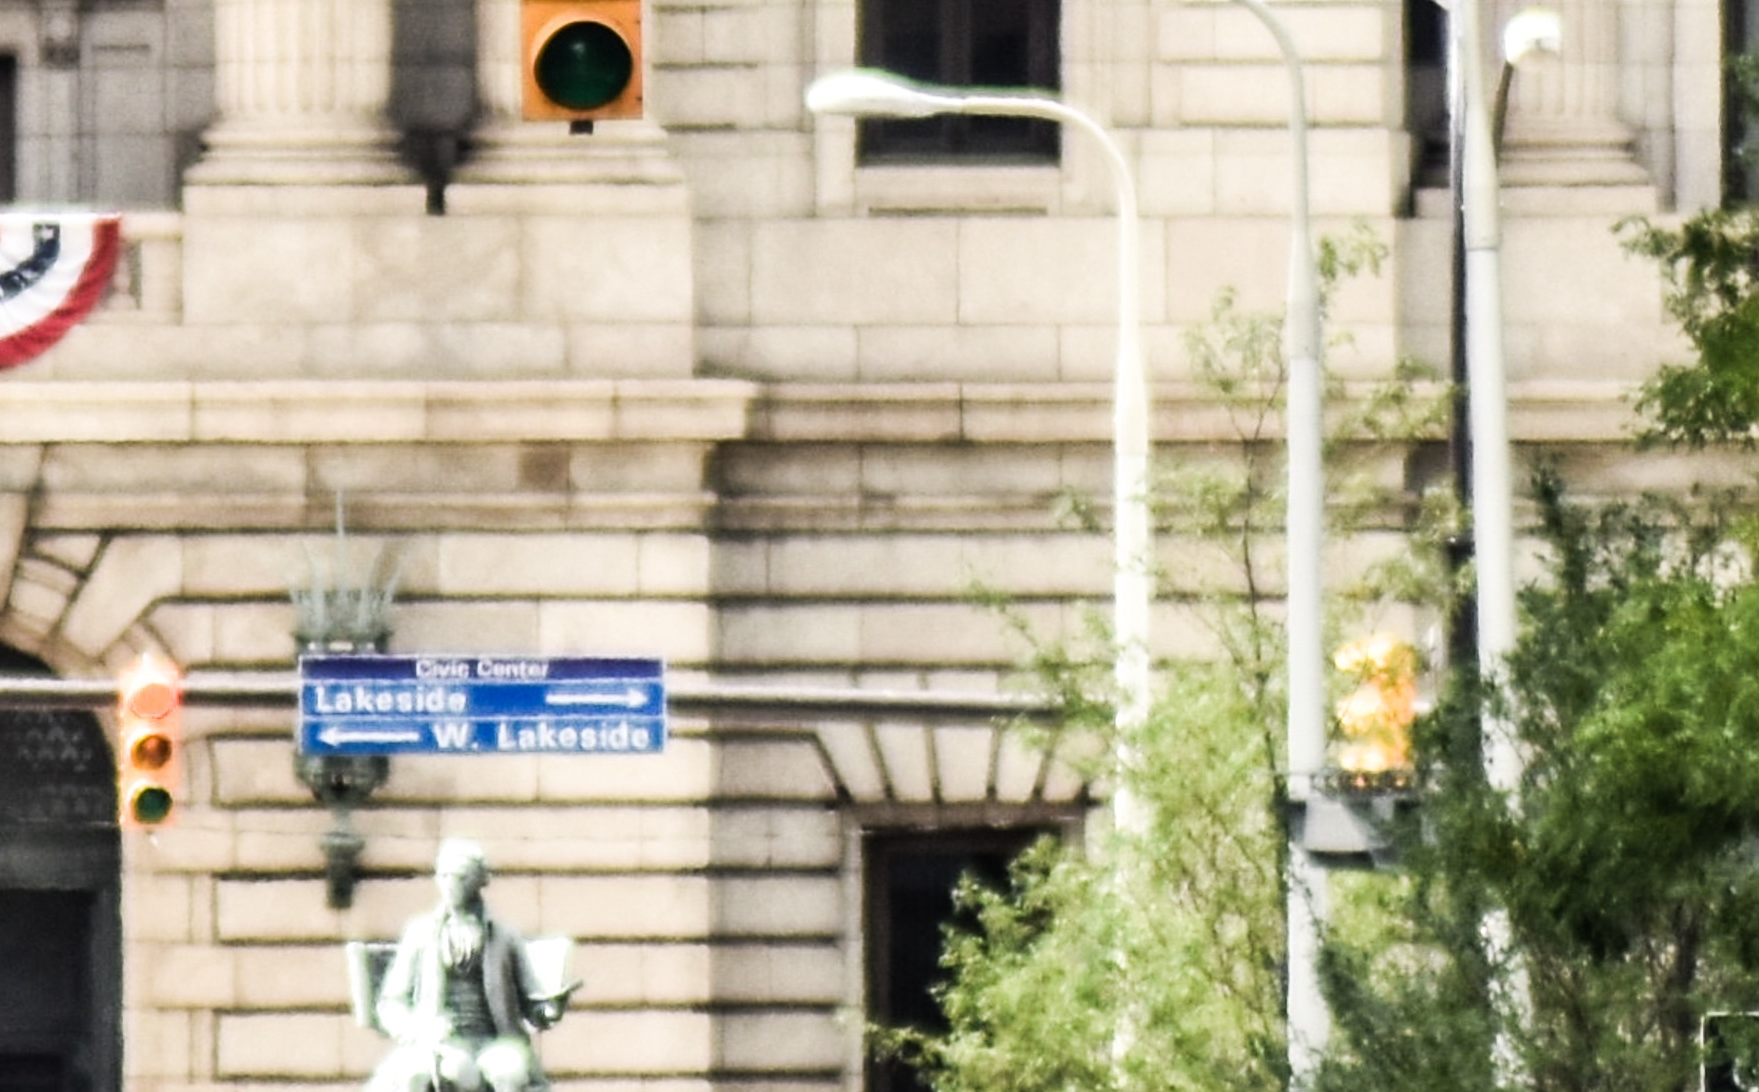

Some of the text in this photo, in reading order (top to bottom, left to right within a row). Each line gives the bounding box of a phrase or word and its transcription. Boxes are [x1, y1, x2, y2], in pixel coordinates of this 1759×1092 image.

[415, 659, 549, 679] Civic Center
[315, 686, 467, 714] Lakeside
[431, 722, 650, 750] W. Lakeside
